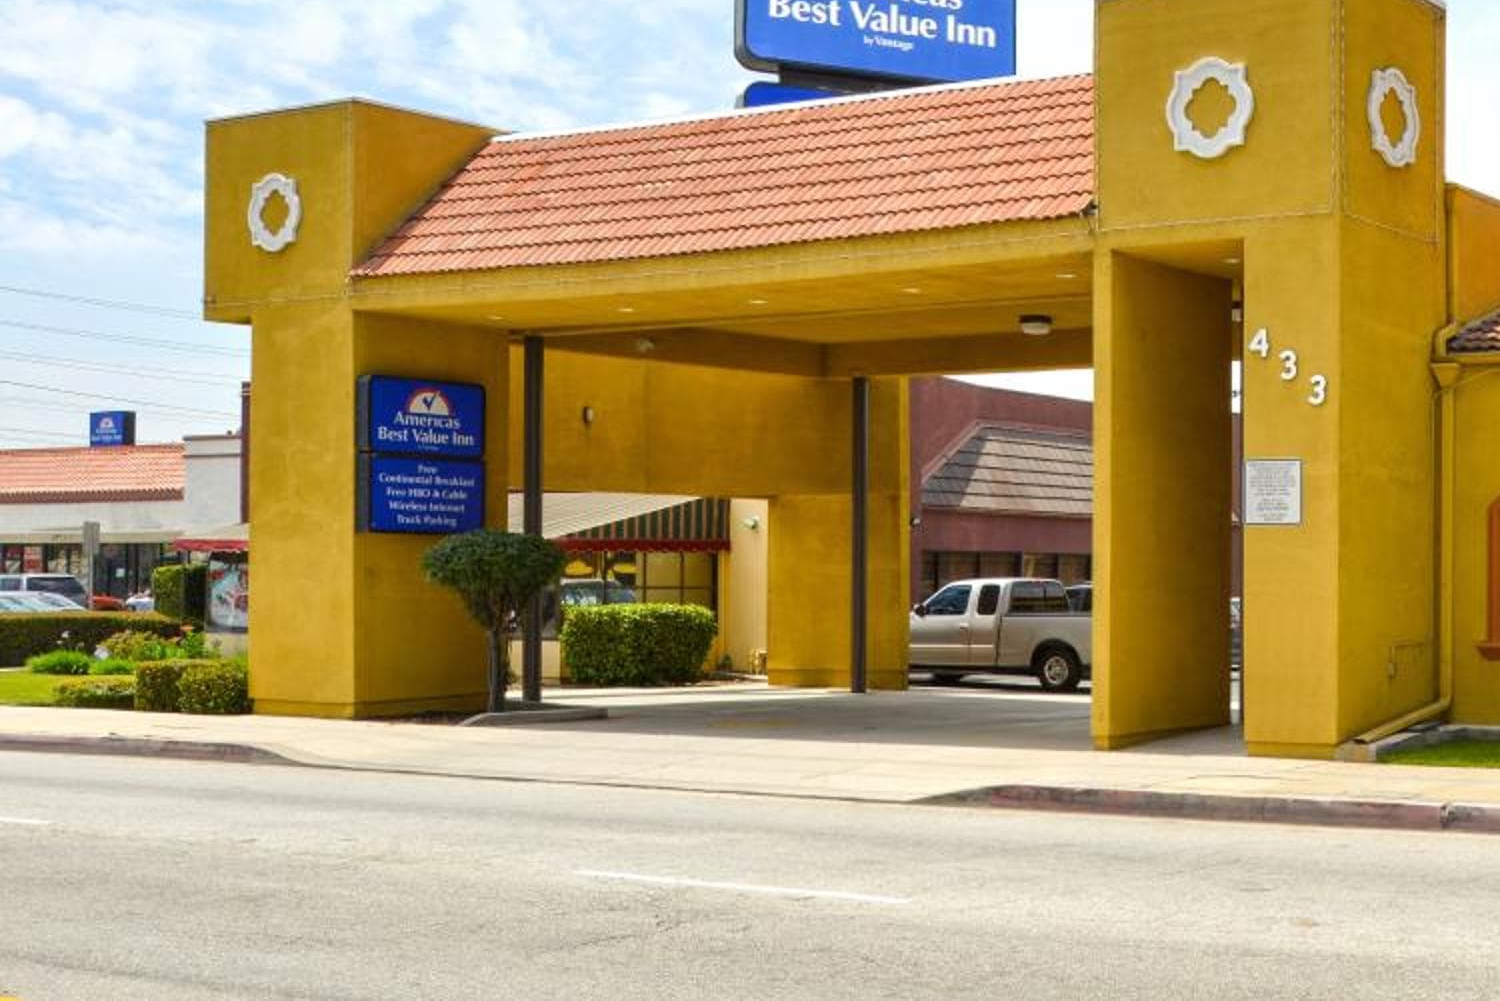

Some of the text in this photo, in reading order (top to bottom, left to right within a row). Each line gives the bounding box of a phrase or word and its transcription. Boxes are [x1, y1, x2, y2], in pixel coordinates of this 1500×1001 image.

[850, 1, 937, 39] Value
[946, 15, 996, 49] Inn
[394, 410, 460, 430] Americas
[377, 426, 475, 446] Best Value Inn
